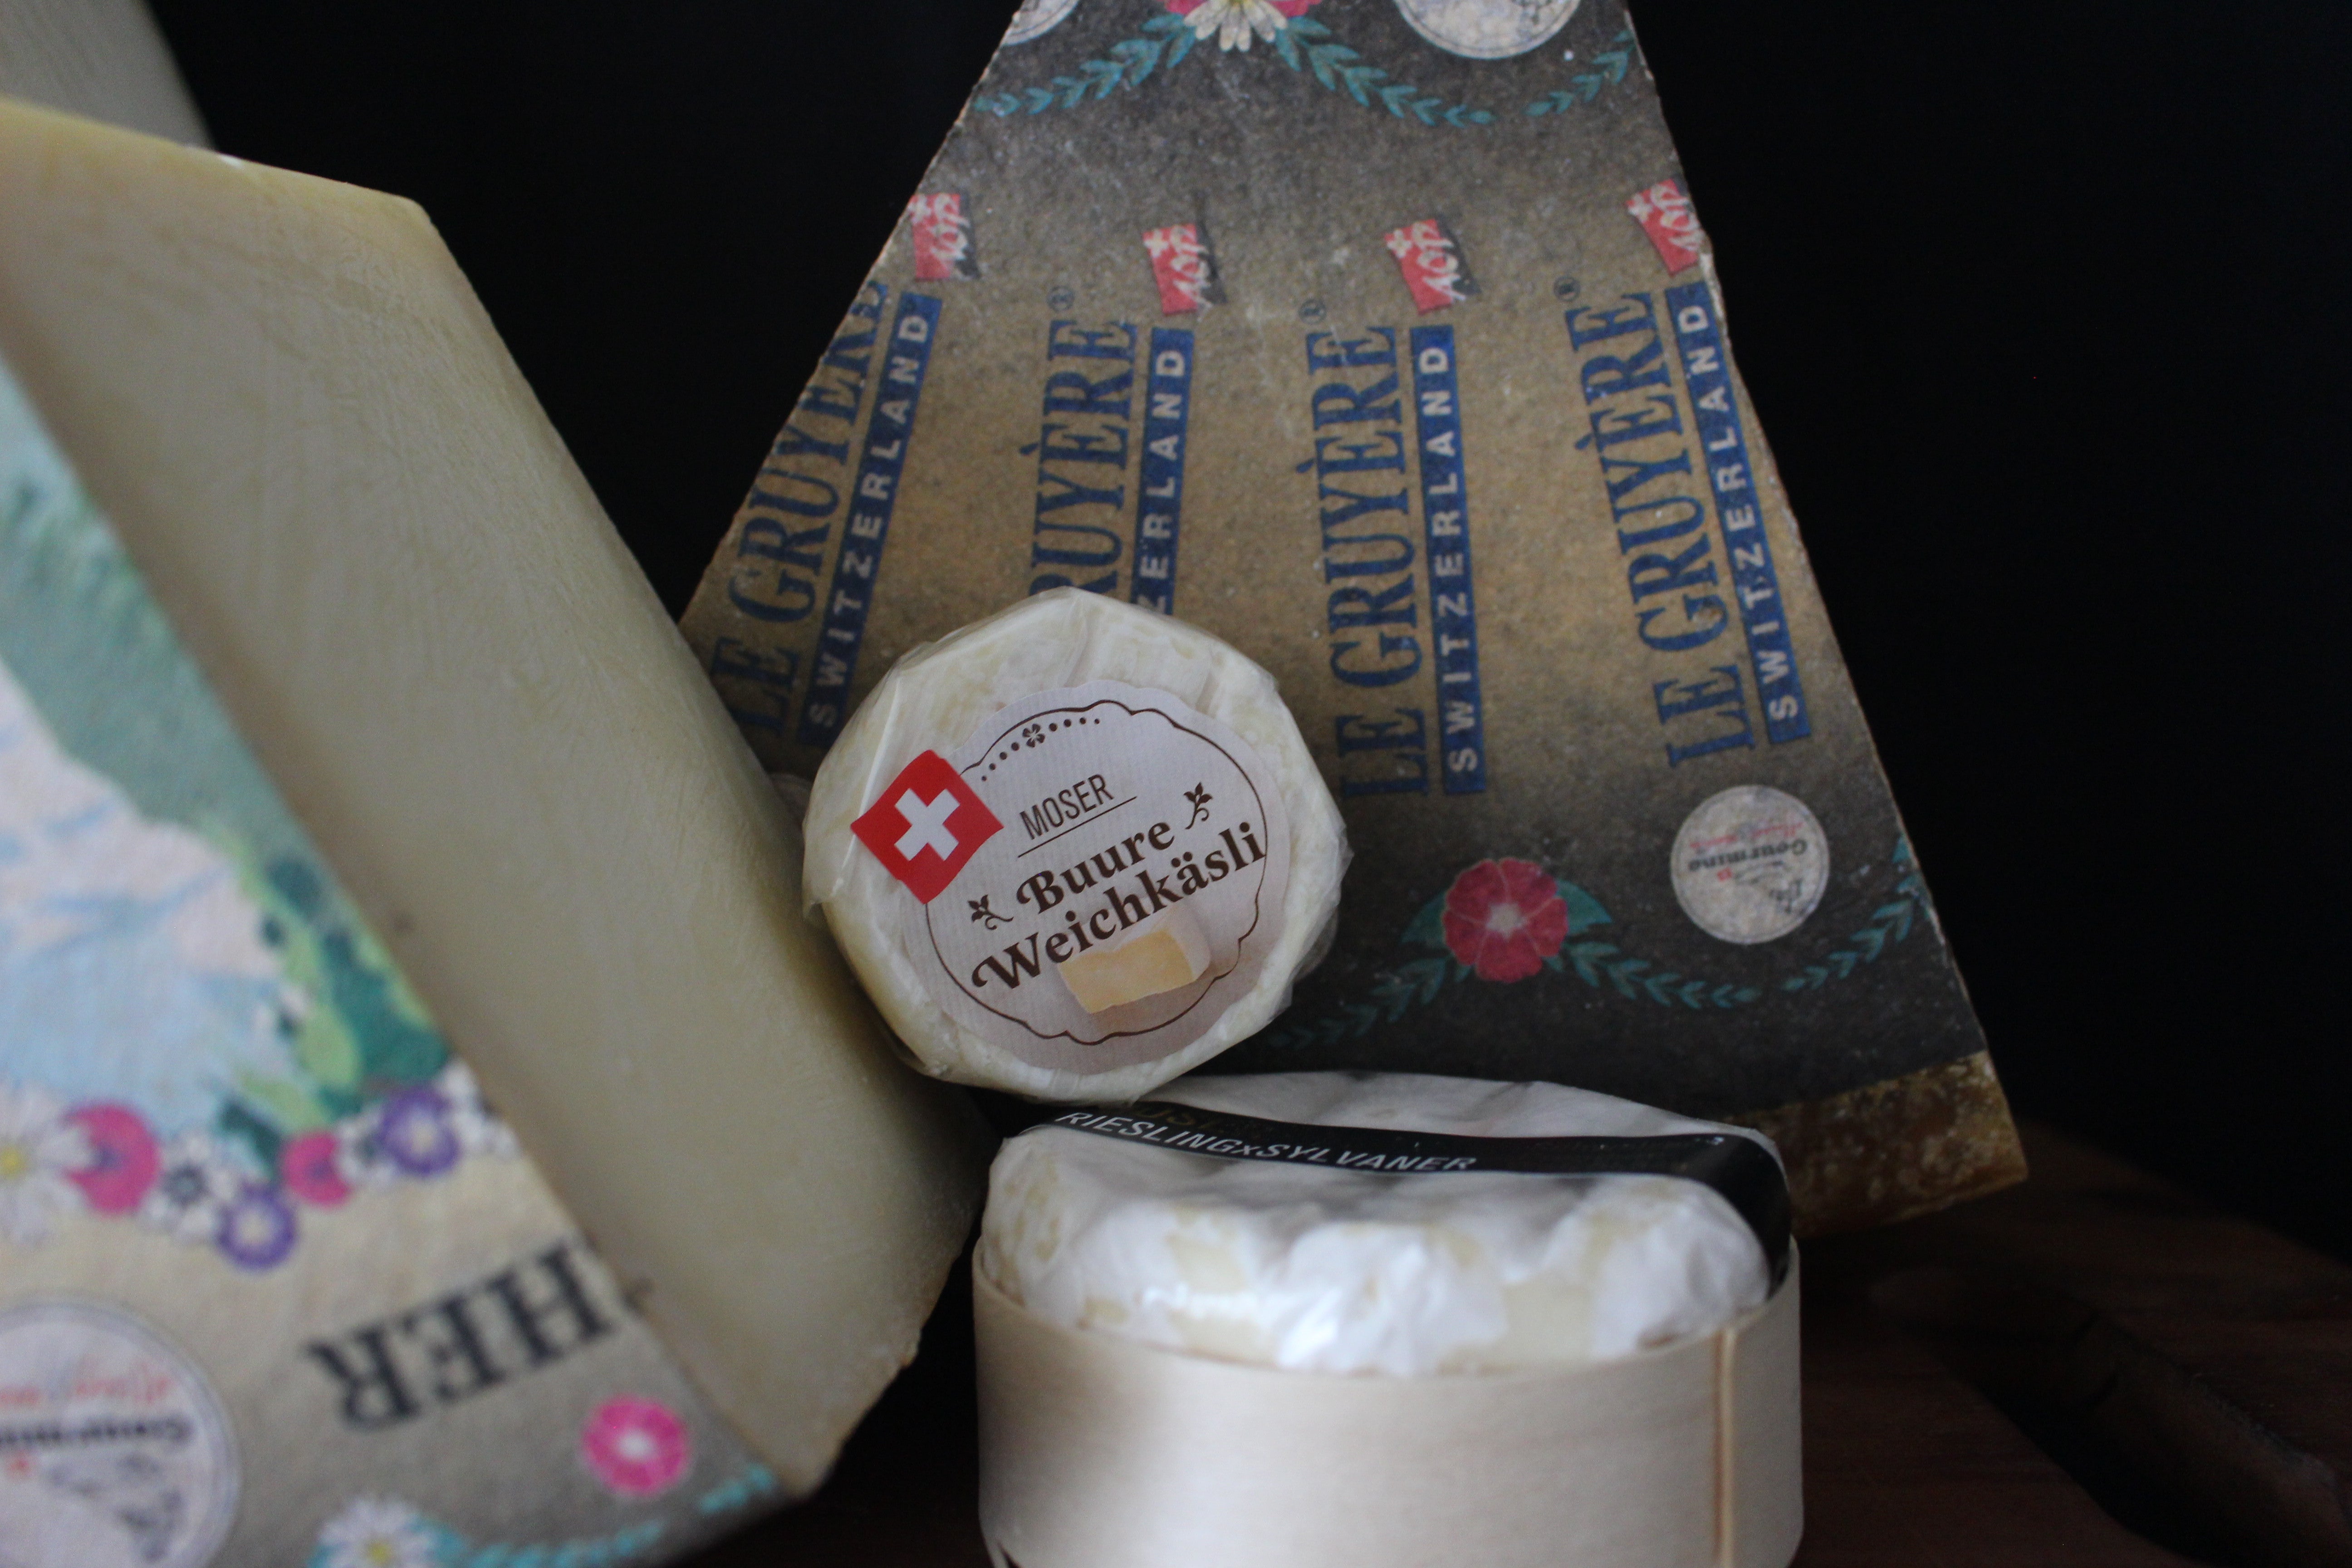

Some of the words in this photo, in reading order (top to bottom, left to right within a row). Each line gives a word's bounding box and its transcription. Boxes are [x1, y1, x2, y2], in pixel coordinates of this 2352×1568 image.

[1169, 225, 1212, 315] AOP
[1411, 221, 1467, 302] AOP
[808, 314, 929, 728] SWITZERLAND
[1417, 346, 1478, 772] SWITZERLAND
[1677, 304, 1799, 720] SWITZERLAND
[710, 637, 800, 737] LE
[1653, 666, 1756, 768] LE
[1338, 708, 1428, 798] LE
[1019, 773, 1114, 838] MOSER
[971, 822, 1265, 990] Weichkäsli
[1017, 820, 1174, 914] Buure
[1055, 1112, 1478, 1171] RIESLINGxSYLVANER
[305, 1244, 613, 1429] HER
